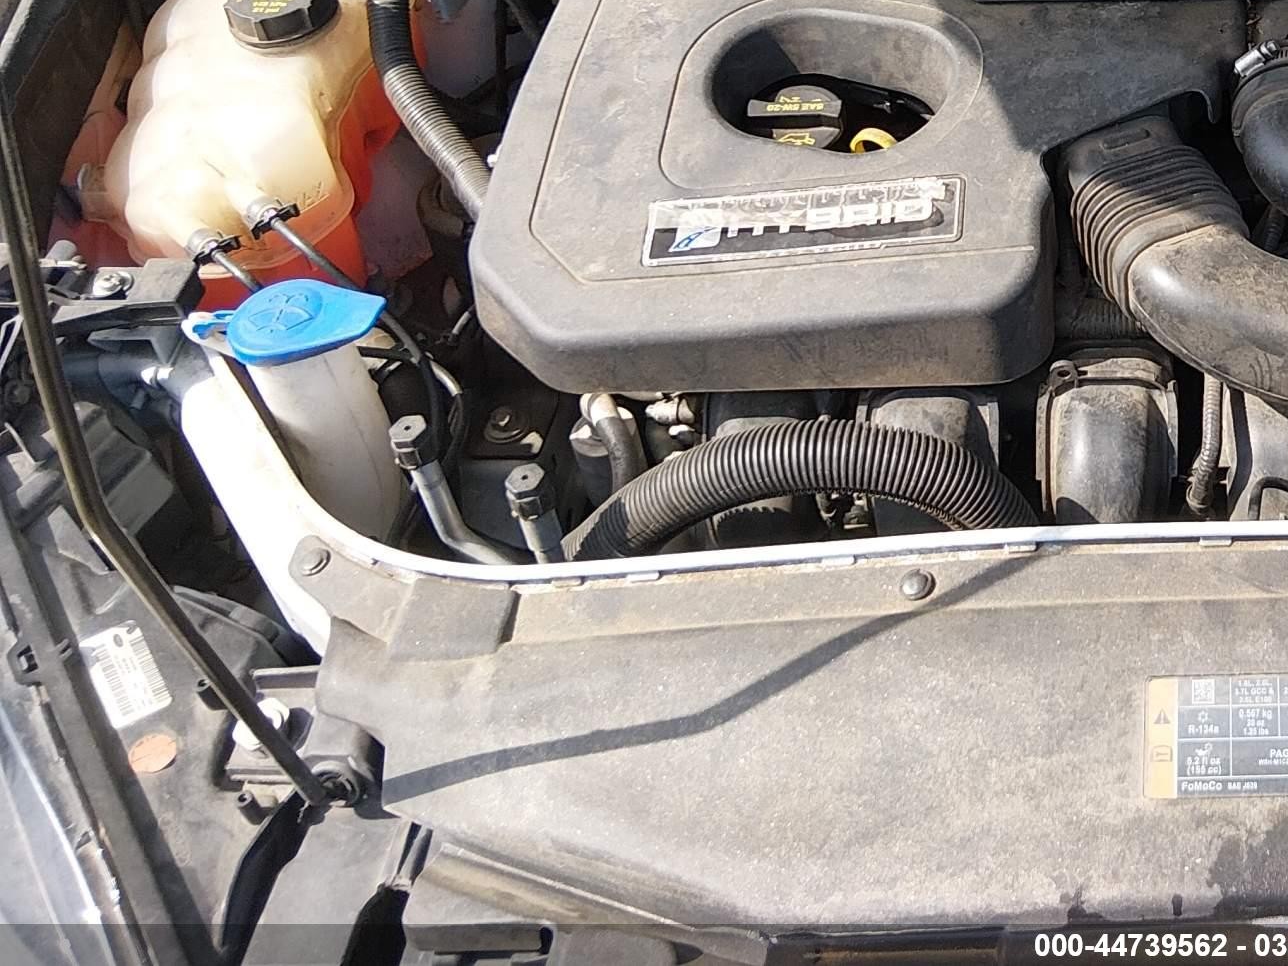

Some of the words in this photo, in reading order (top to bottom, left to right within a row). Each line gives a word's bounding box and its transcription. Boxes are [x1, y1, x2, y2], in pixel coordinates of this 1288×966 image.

[766, 104, 800, 112] 5W-20
[800, 103, 824, 111] SAE
[1239, 708, 1260, 718] 0.567
[1262, 707, 1273, 720] kg
[1188, 723, 1219, 734] R-134a
[1258, 726, 1269, 735] lbs
[1210, 757, 1221, 765] oz
[1181, 780, 1223, 792] FoMoCo
[1227, 781, 1241, 791] SAE
